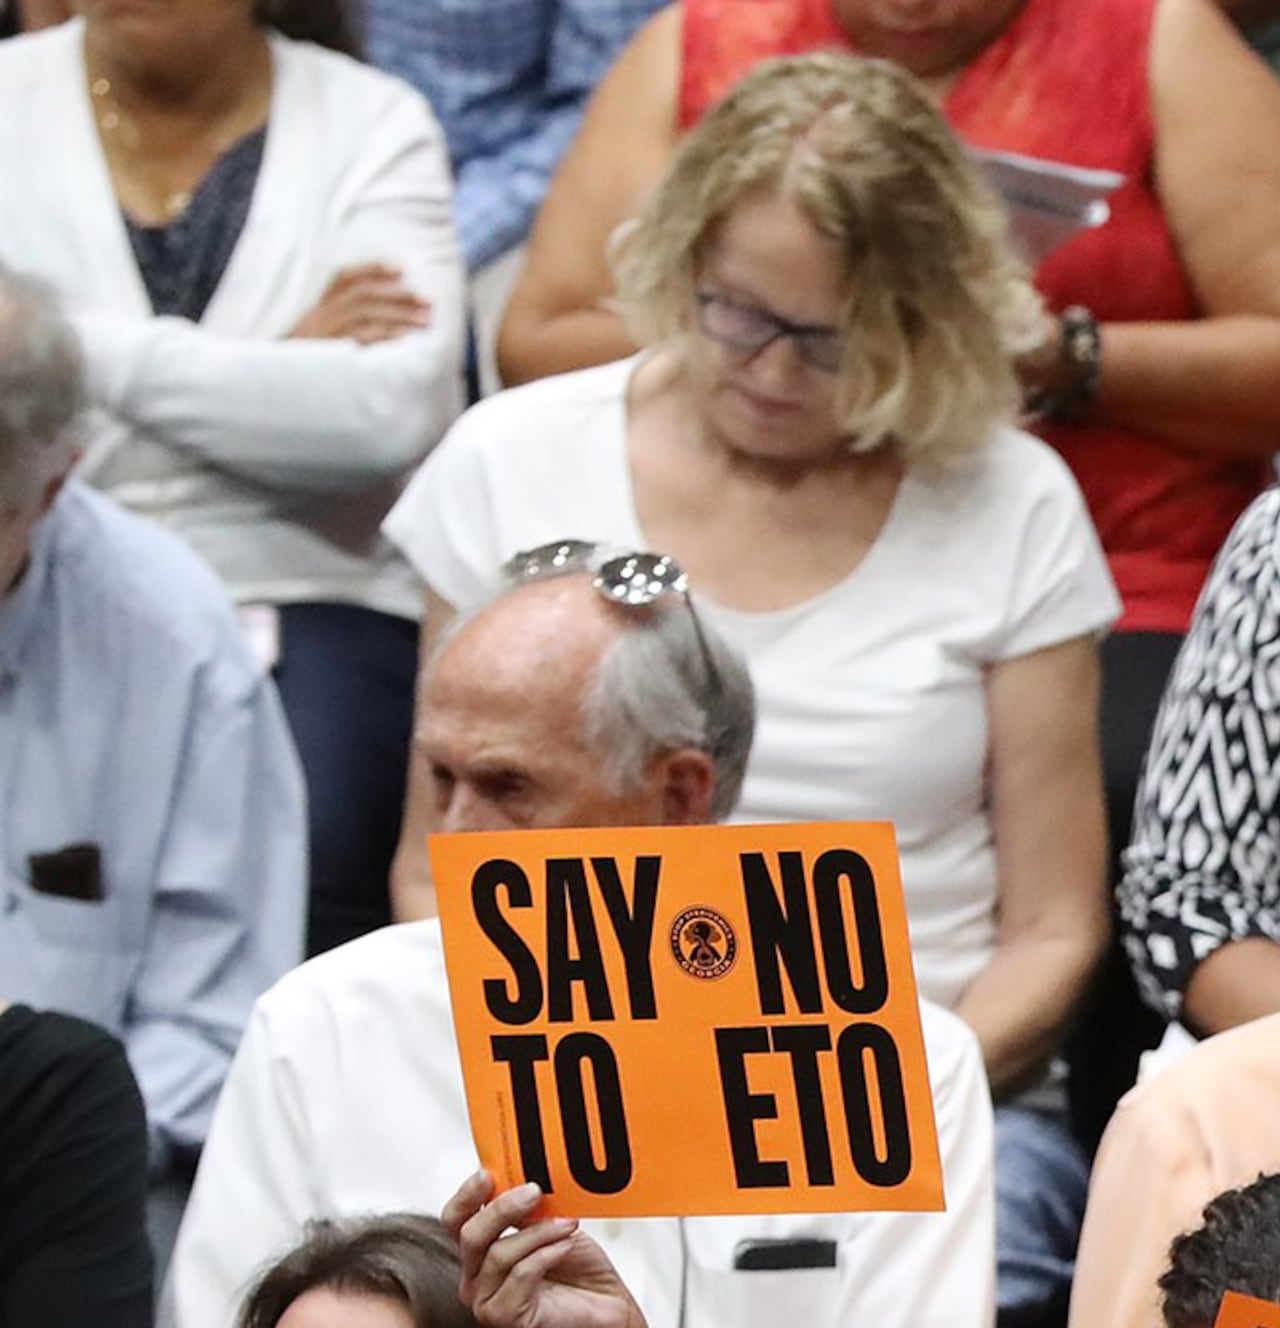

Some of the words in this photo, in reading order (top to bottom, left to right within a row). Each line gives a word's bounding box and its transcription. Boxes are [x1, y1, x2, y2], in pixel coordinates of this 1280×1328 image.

[472, 856, 661, 1025] SAY
[740, 849, 888, 1015] NO
[490, 1032, 632, 1195] TO
[715, 1023, 911, 1188] ETO
